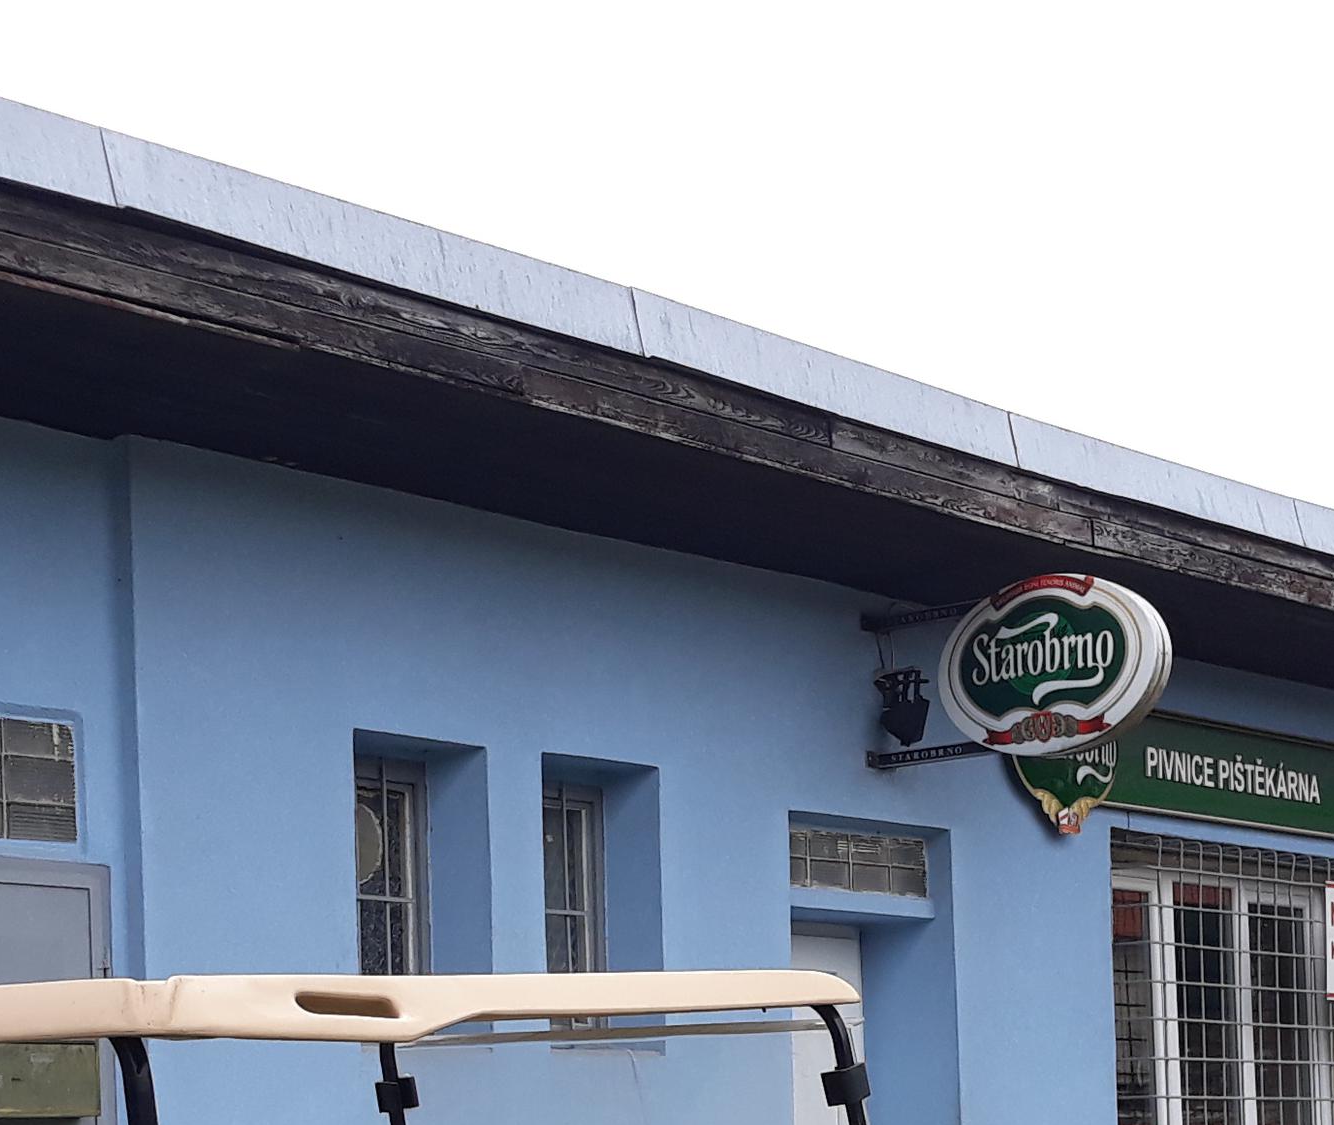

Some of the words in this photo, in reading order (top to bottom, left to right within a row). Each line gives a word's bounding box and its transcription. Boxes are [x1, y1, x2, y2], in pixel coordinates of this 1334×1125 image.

[971, 612, 1115, 706] Starobrno
[891, 745, 963, 762] STAROBRNO
[1145, 746, 1215, 787] PIVNICE
[1218, 753, 1321, 804] PIŠTĚKÁRNA
